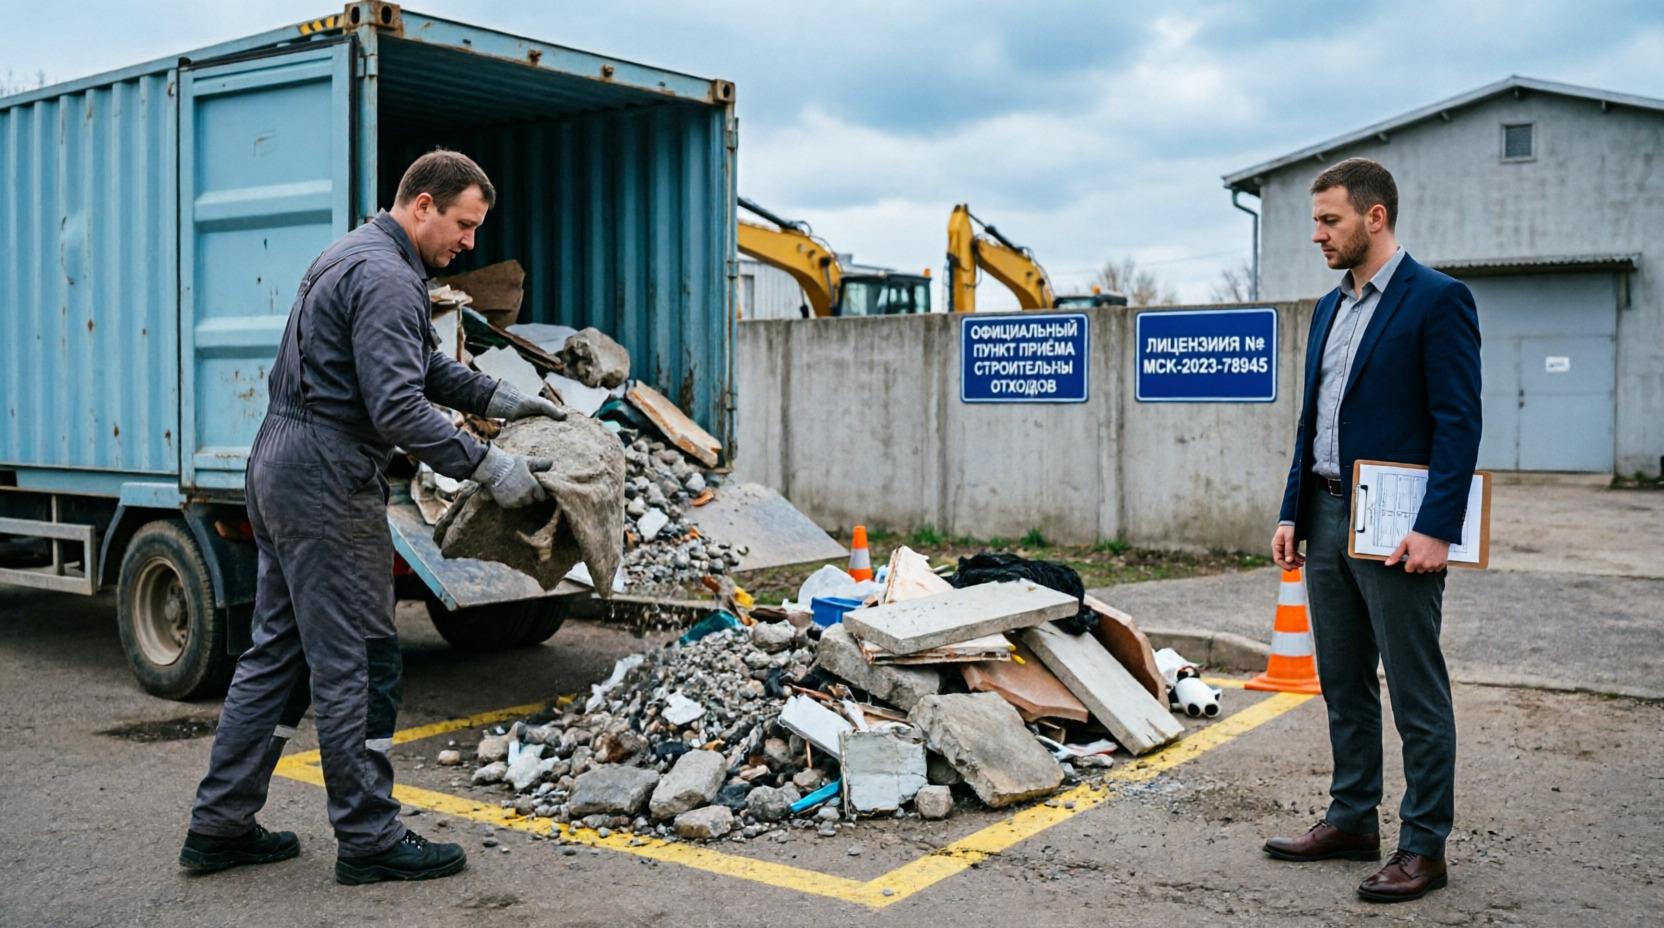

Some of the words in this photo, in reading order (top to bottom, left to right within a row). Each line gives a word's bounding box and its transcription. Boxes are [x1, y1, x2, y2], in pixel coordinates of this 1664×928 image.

[971, 320, 1078, 340] ОФИЦИАЛЬНЫЙ
[973, 343, 1016, 358] ПУНКТ
[974, 361, 1073, 375] СТРОИТЕЛЬНЫ
[1143, 358, 1268, 373] МСК-2023-78945
